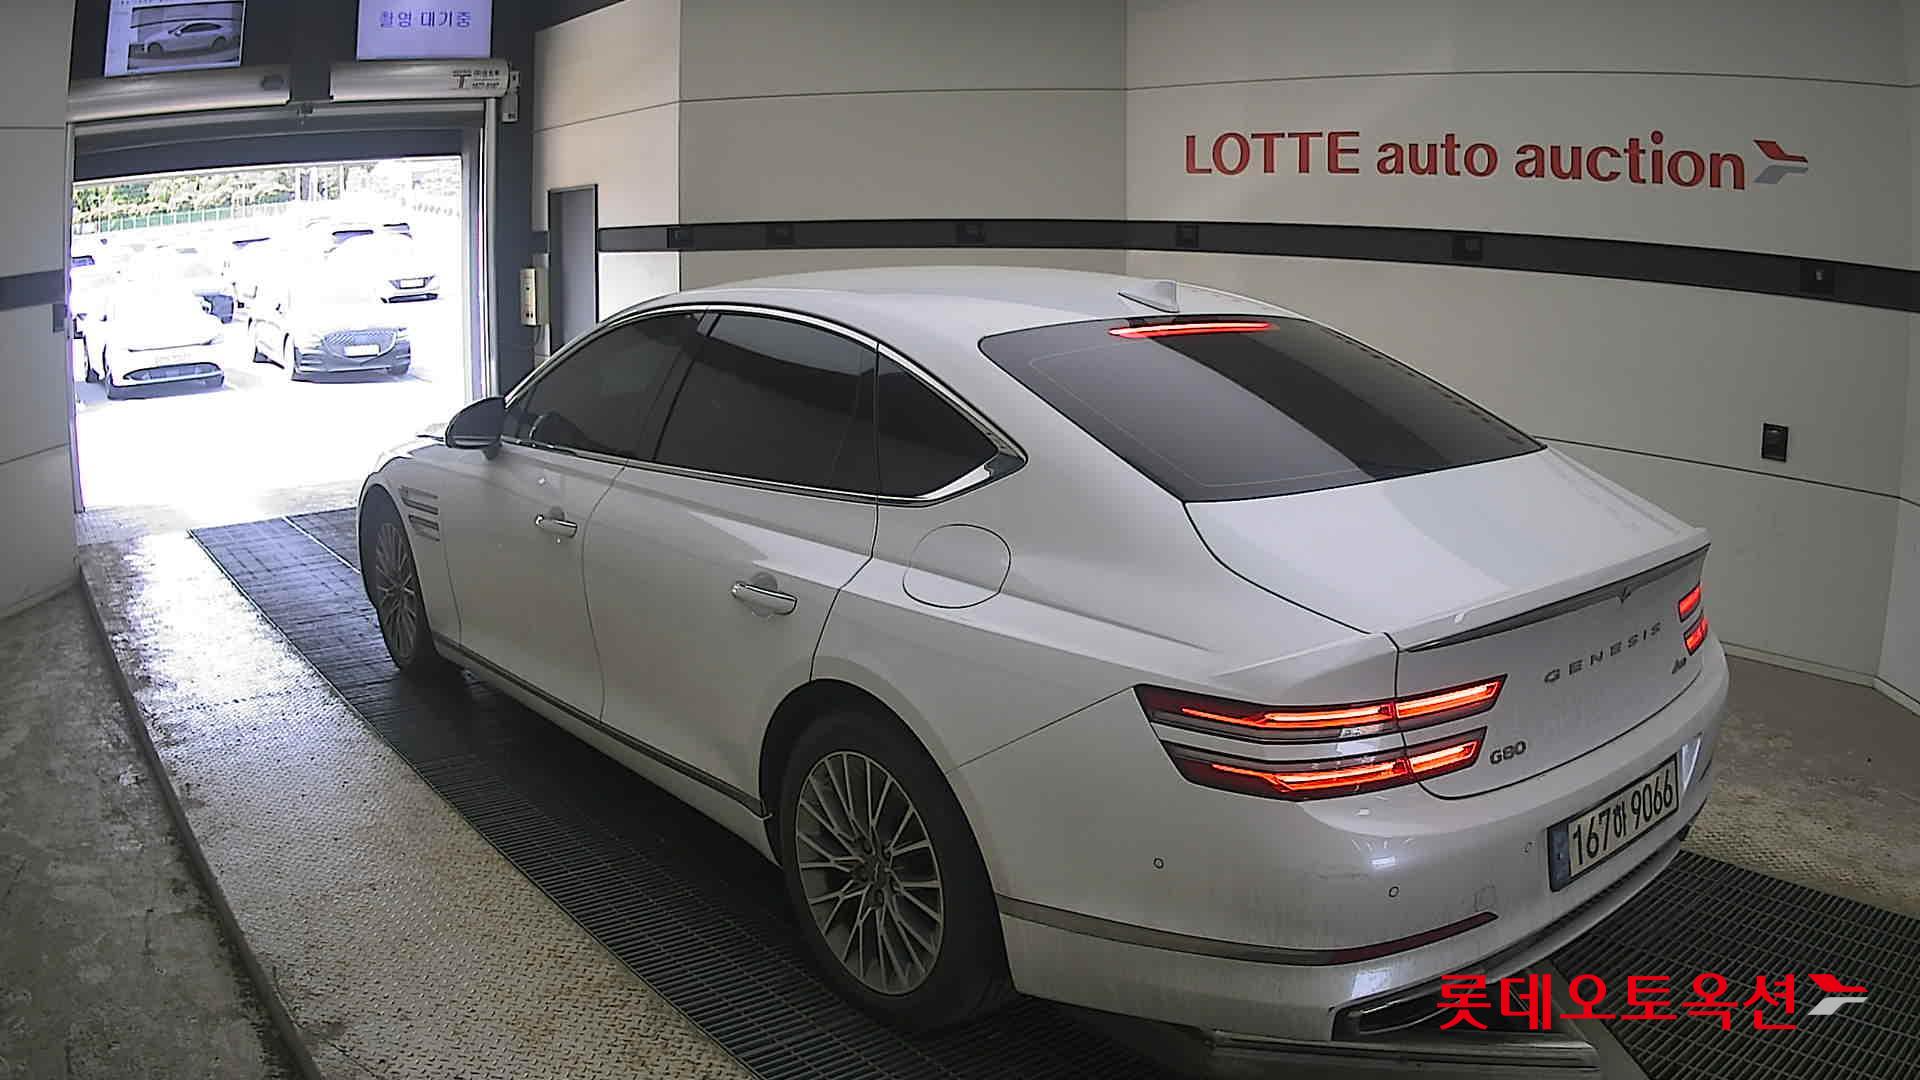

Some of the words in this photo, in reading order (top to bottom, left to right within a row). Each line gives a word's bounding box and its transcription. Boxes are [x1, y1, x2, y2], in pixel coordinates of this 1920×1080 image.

[421, 11, 471, 28] 대기중
[1185, 131, 1361, 176] LOTTE
[1376, 134, 1498, 178] auto
[1514, 131, 1746, 190] auction
[1543, 622, 1663, 684] GENESIS
[1489, 740, 1527, 766] G80
[1572, 801, 1627, 866] 167하
[1630, 768, 1674, 831] 9066
